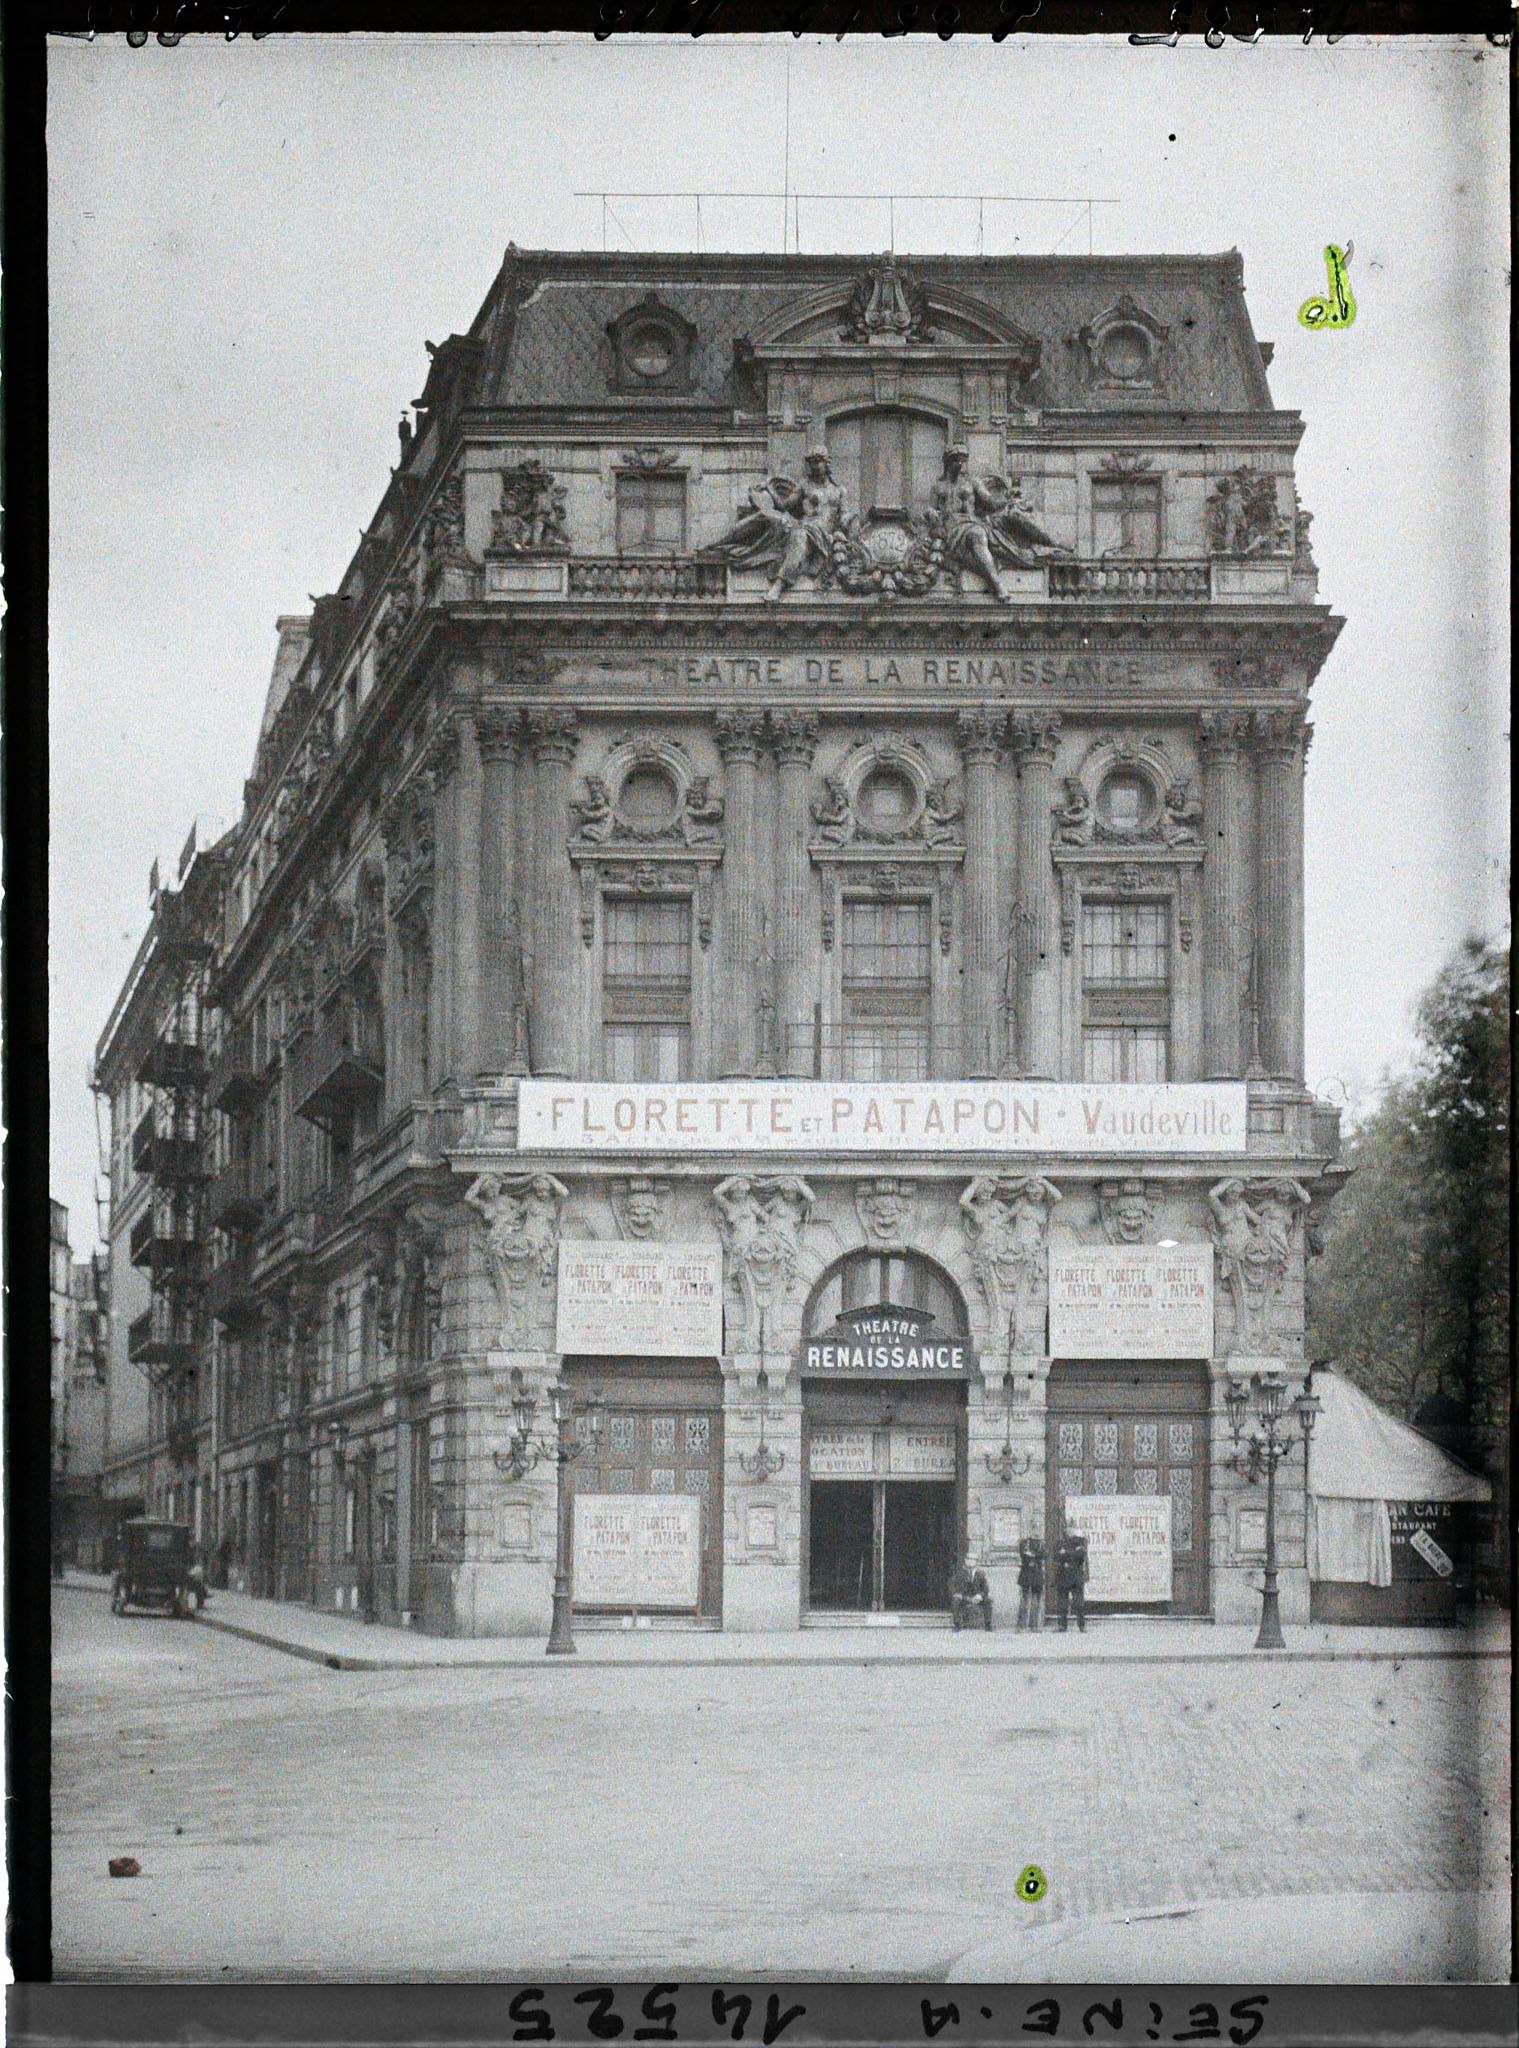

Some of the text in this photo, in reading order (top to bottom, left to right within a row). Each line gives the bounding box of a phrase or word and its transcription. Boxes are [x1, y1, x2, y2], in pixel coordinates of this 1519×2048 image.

[806, 659, 843, 685] DE
[866, 659, 903, 685] LA
[923, 659, 1143, 686] RENAISSANCE
[551, 1098, 1232, 1136] FLORETTE ET PATAPON Vaudeville
[853, 1319, 919, 1338] THEATRE
[888, 1335, 900, 1344] LA
[807, 1347, 964, 1369] RENAISSANCE
